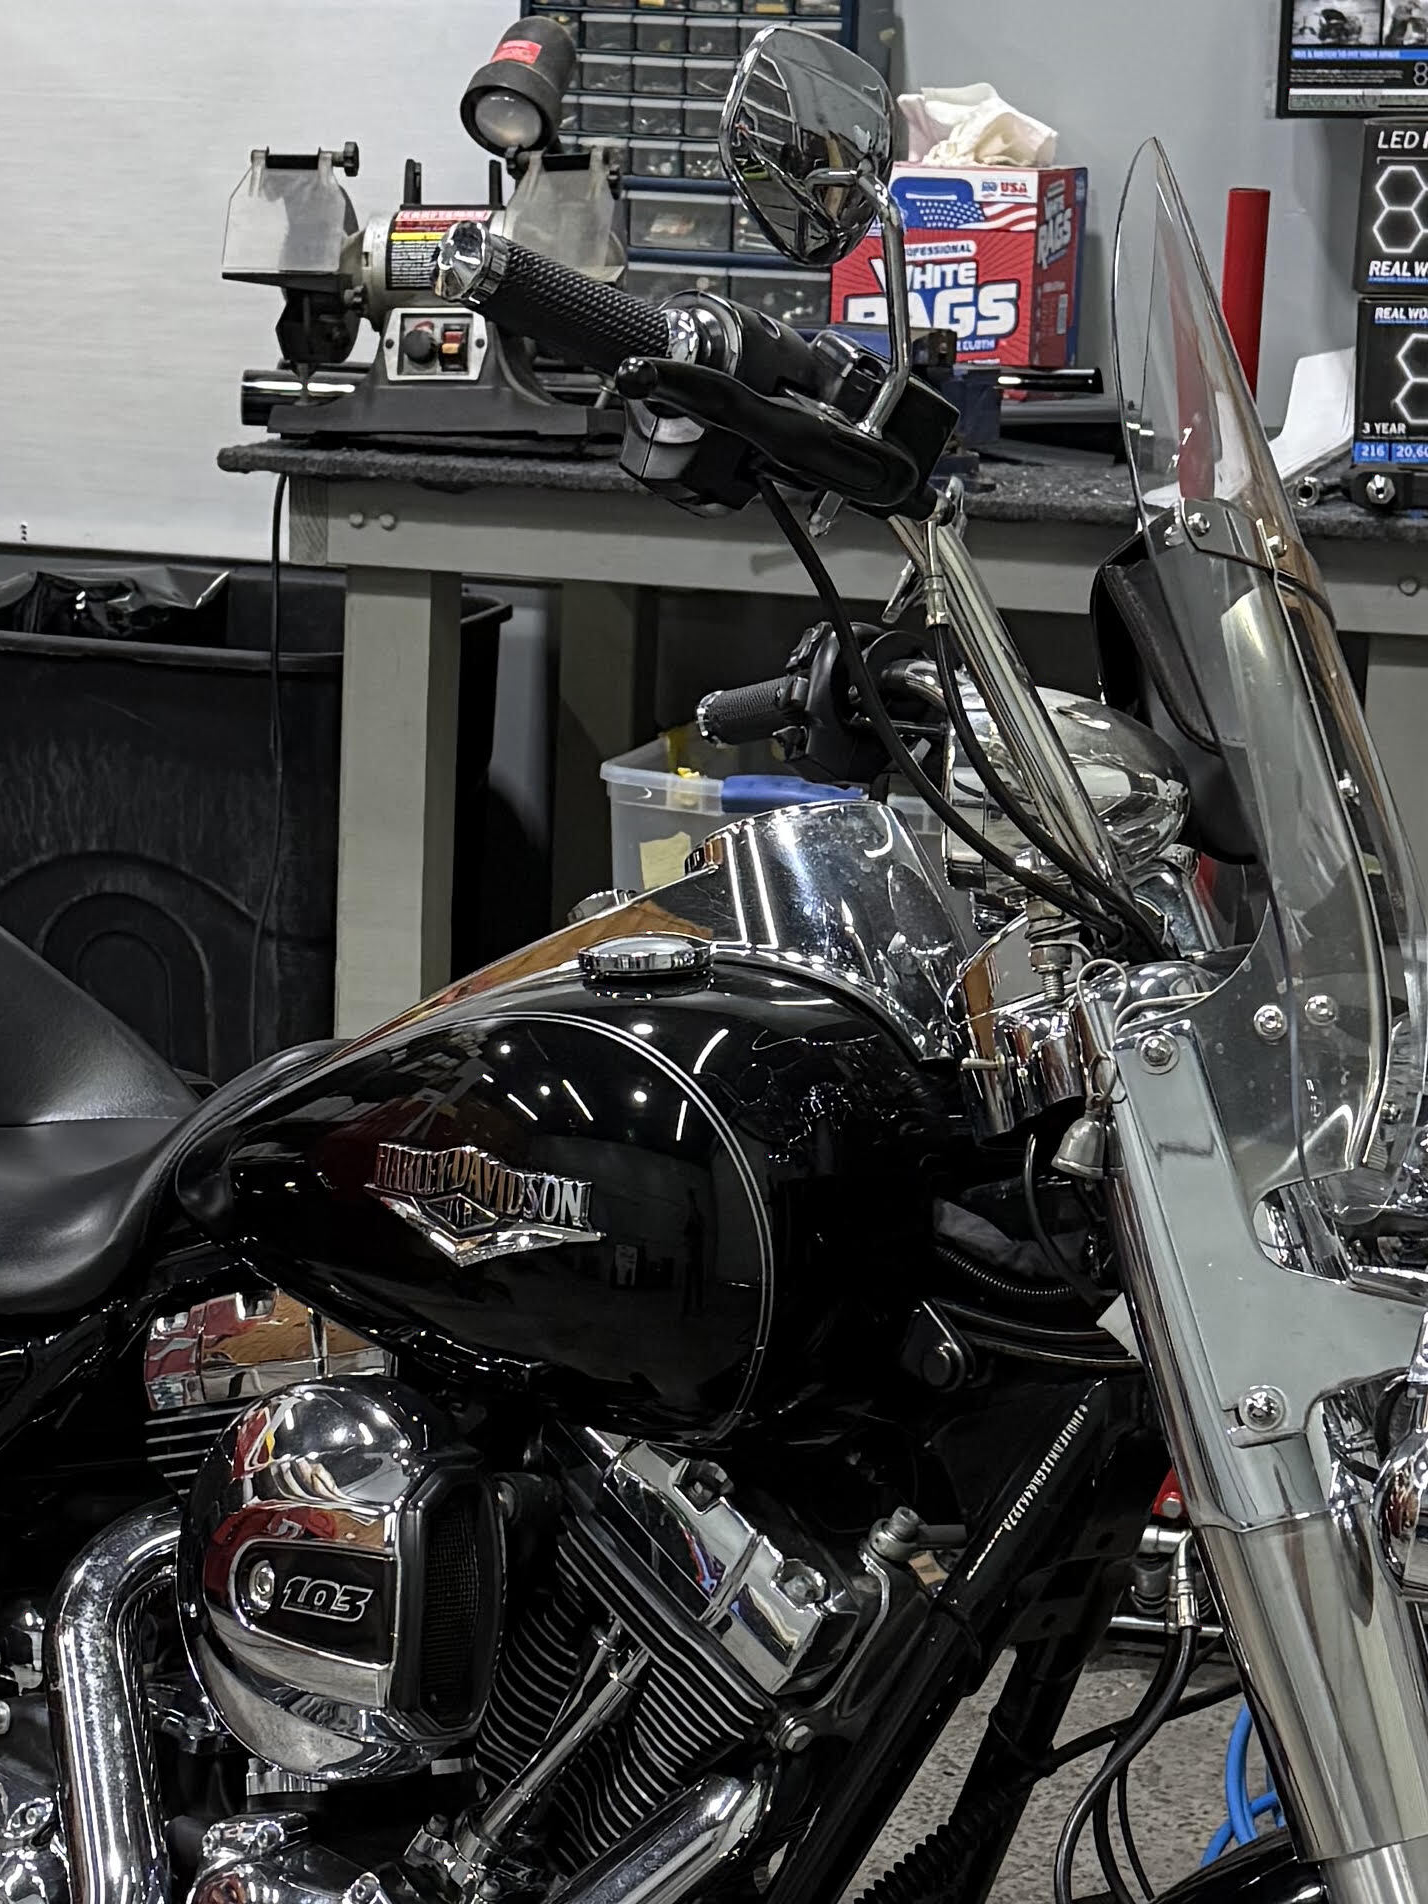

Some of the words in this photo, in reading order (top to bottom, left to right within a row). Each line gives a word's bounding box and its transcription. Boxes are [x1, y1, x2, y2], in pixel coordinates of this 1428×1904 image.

[1377, 131, 1419, 149] LED
[1000, 181, 1028, 194] USA
[1369, 261, 1411, 276] REAL
[1374, 307, 1408, 319] REAL
[1362, 422, 1371, 435] 3
[1374, 422, 1407, 435] YEAR
[1361, 445, 1385, 457] 216
[281, 1576, 374, 1623] 103
